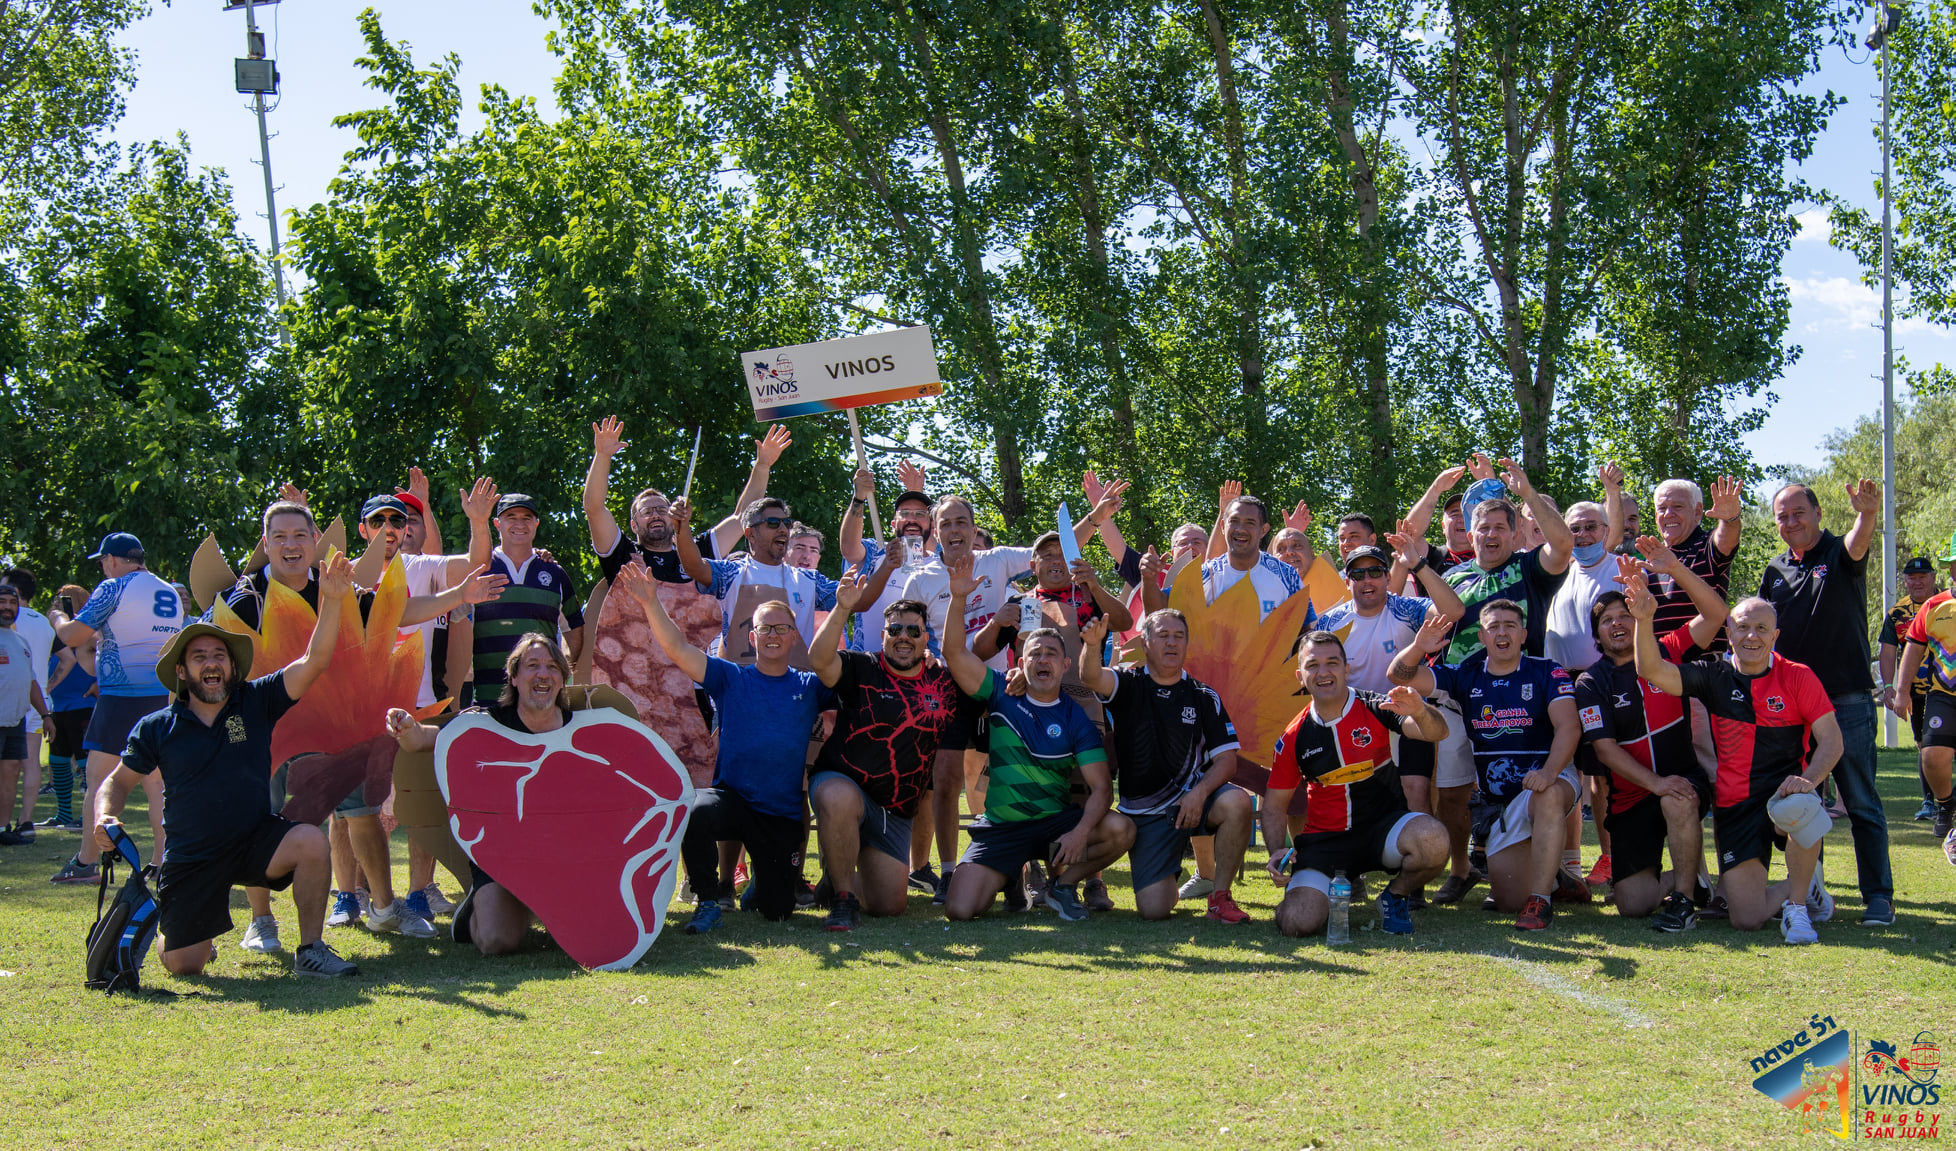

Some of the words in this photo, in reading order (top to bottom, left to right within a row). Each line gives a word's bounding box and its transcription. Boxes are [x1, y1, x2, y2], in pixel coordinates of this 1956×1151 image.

[825, 355, 895, 379] VINOS
[756, 381, 798, 397] VINOS
[153, 590, 177, 618] 8
[1496, 707, 1528, 718] GRANJA
[1584, 714, 1601, 724] asa
